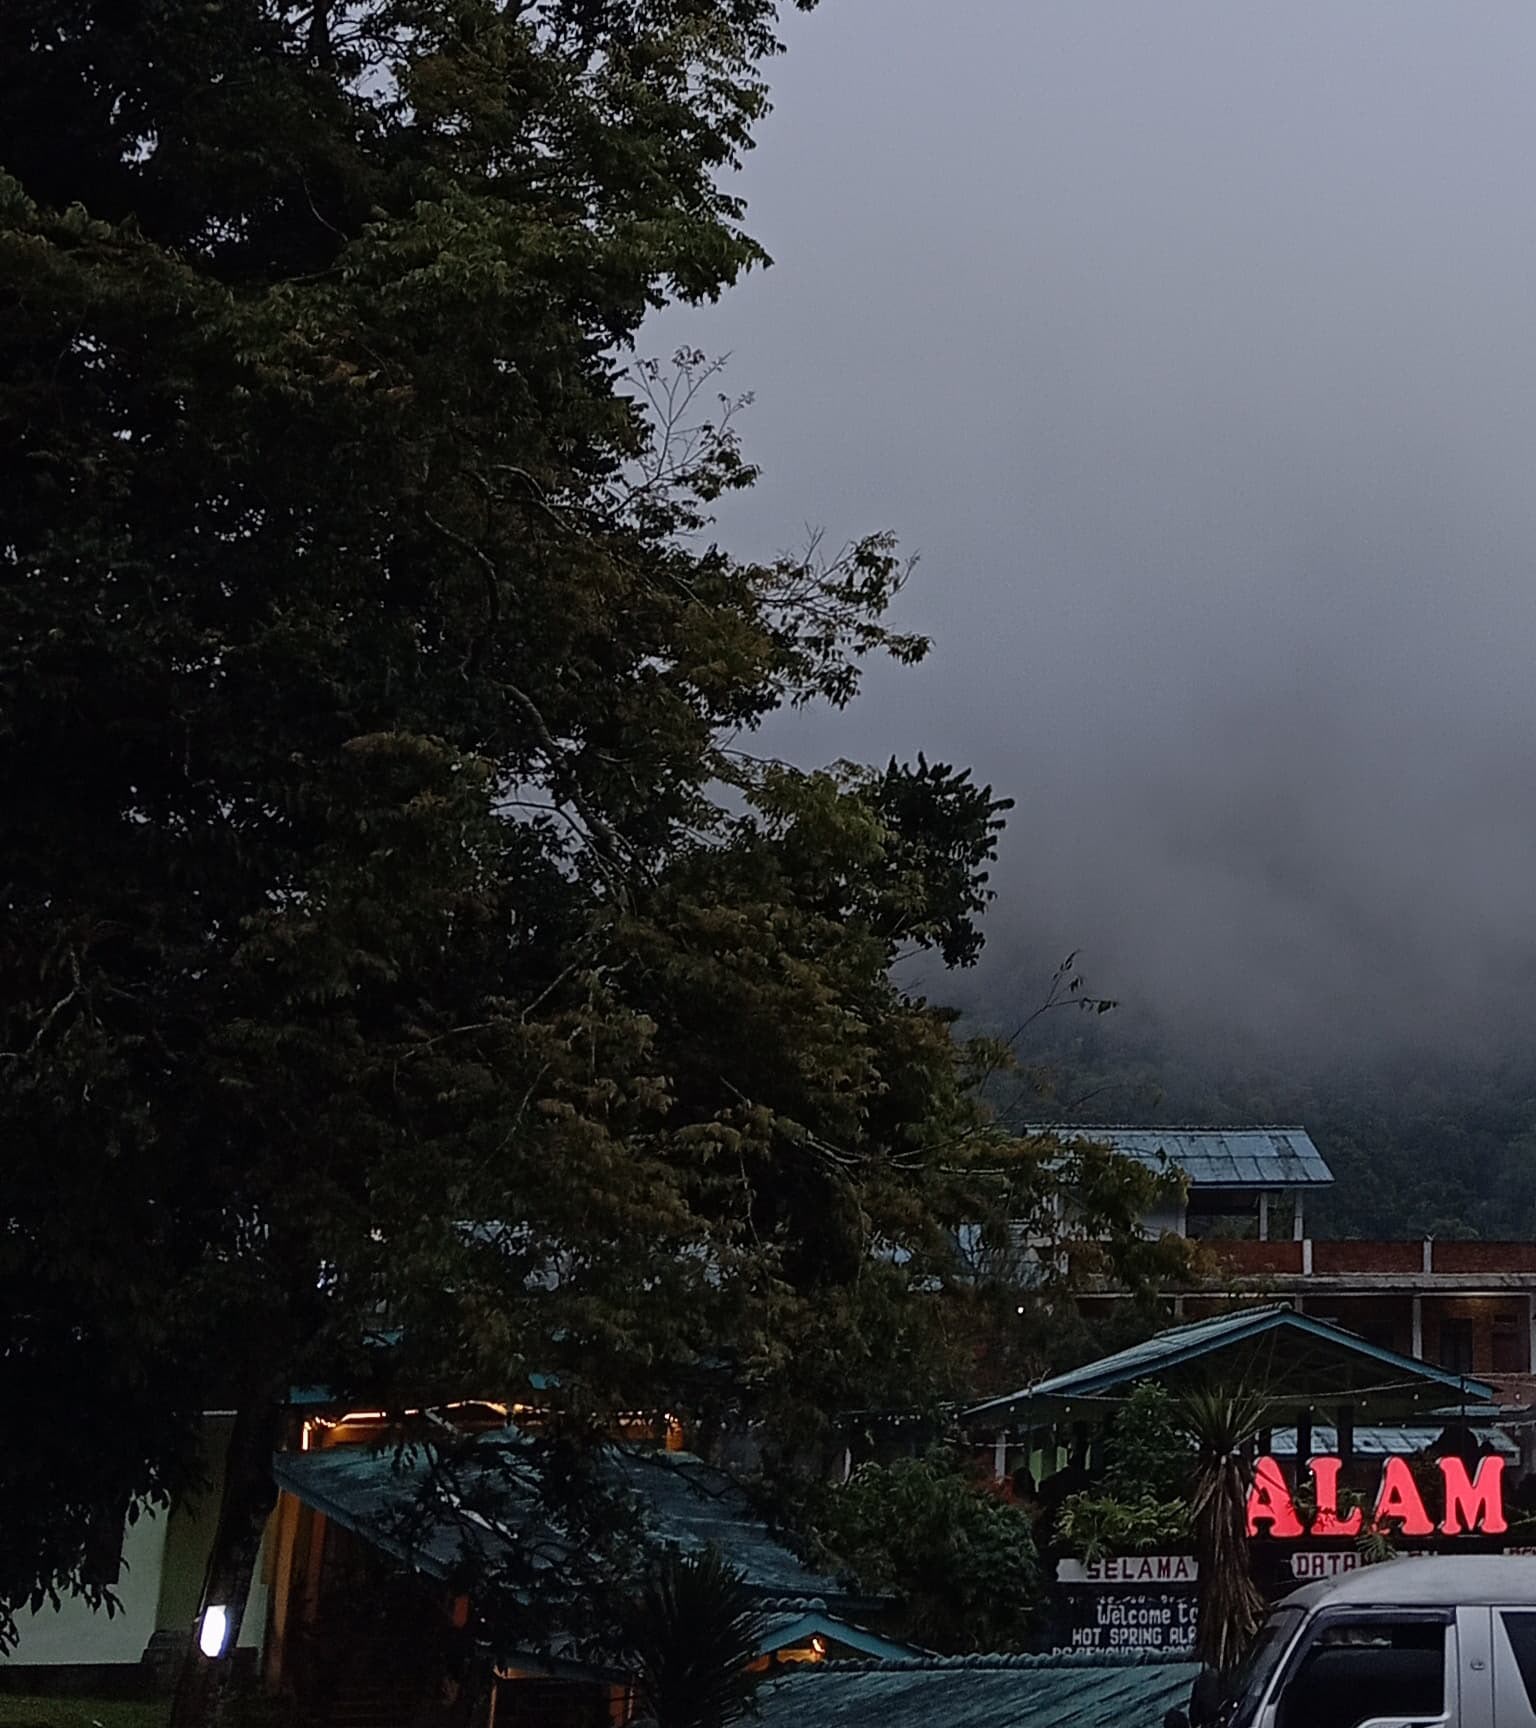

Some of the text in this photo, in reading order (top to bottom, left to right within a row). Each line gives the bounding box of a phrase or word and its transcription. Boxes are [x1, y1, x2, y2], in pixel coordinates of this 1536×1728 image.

[1245, 1455, 1509, 1537] ALAM
[1086, 1558, 1198, 1579] SELAMA
[1097, 1604, 1172, 1626] Welcome
[1072, 1628, 1102, 1646] HOT
[1109, 1627, 1162, 1646] SPRING
